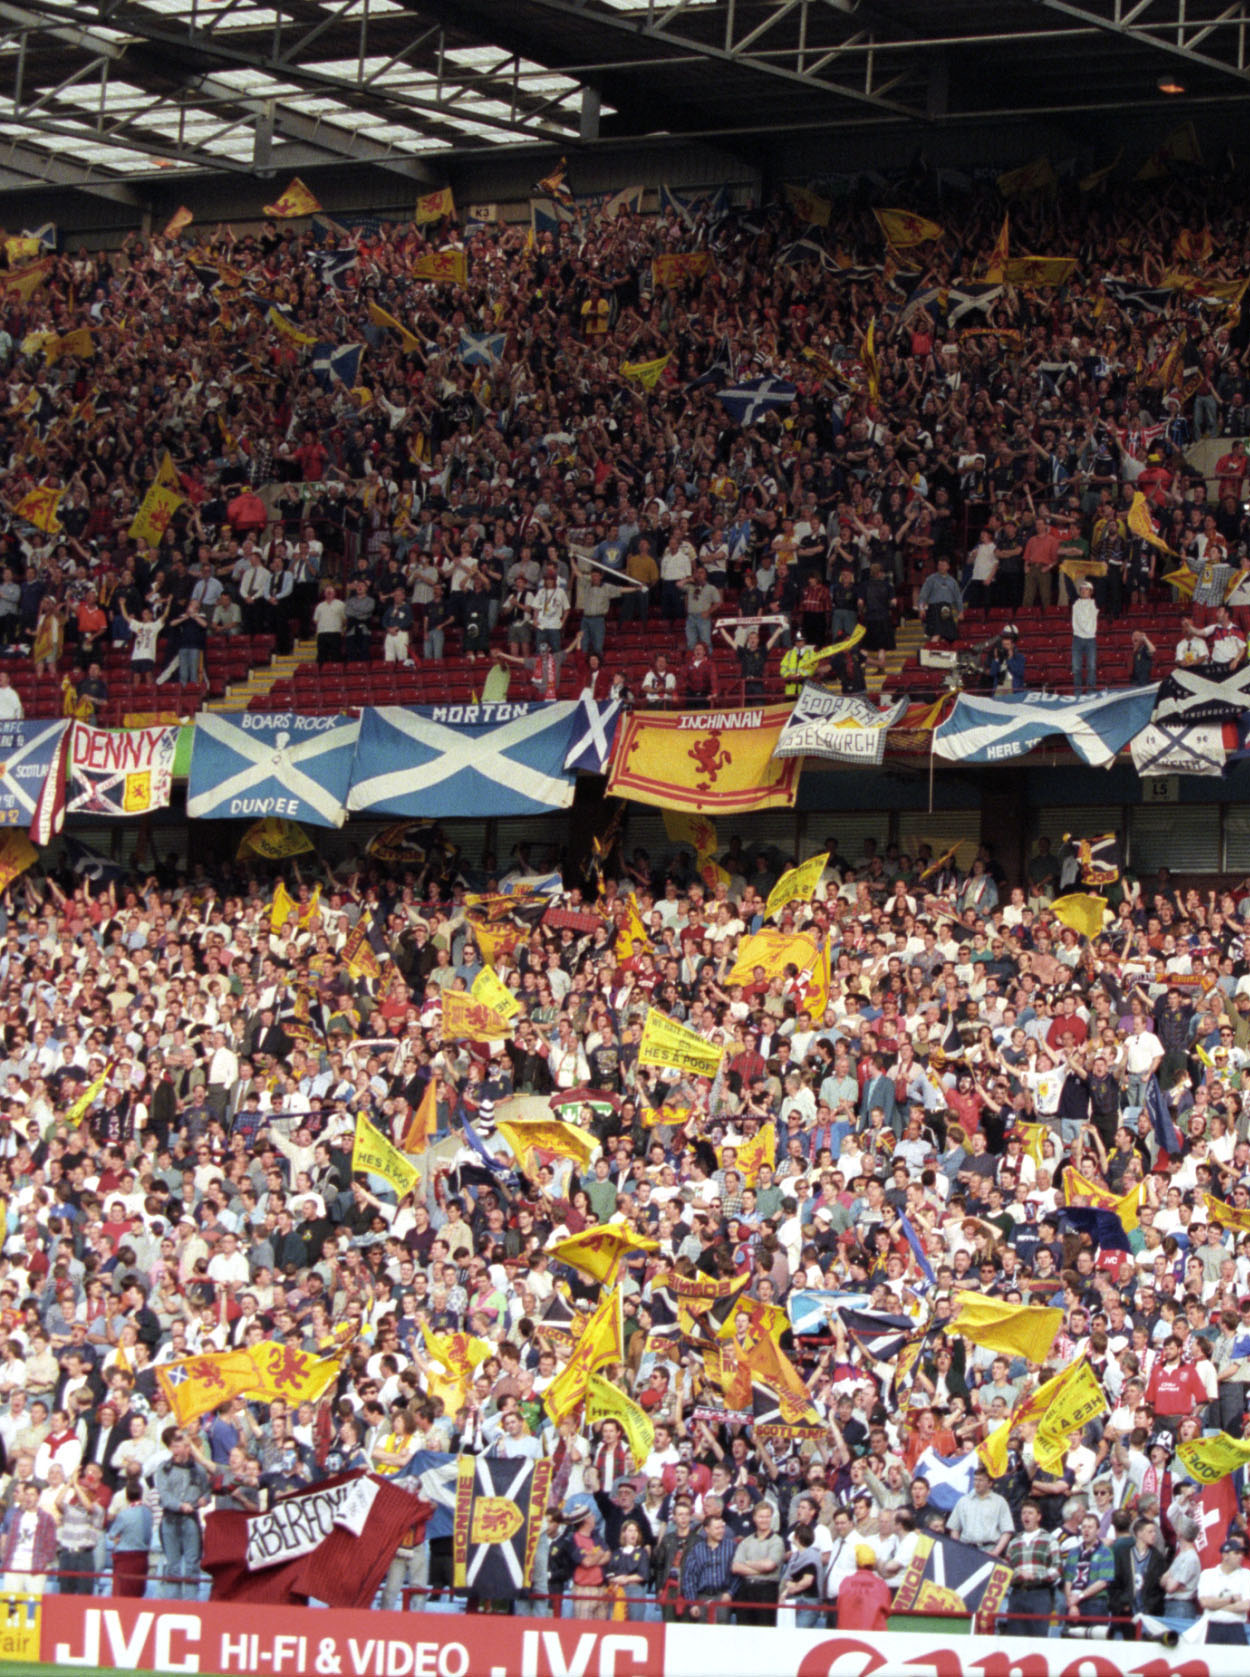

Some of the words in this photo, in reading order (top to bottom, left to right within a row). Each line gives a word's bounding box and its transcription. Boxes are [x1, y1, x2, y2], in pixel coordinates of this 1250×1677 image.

[241, 713, 290, 730] BOARS
[294, 714, 338, 731] ROCK
[432, 703, 529, 724] MORTON
[677, 710, 764, 730] INCHINNAN
[73, 725, 168, 770] DENNY
[986, 741, 1022, 760] HERE
[15, 764, 49, 778] SCOTLA
[1152, 783, 1168, 796] L5
[230, 797, 299, 816] DUNDEE
[644, 1047, 669, 1060] HES
[455, 1476, 473, 1564] BONNIE
[55, 1608, 201, 1674] JVC
[221, 1633, 309, 1672] HI-FI
[315, 1636, 343, 1675] &
[347, 1638, 470, 1677] VIDEO
[490, 1629, 649, 1677] JVC
